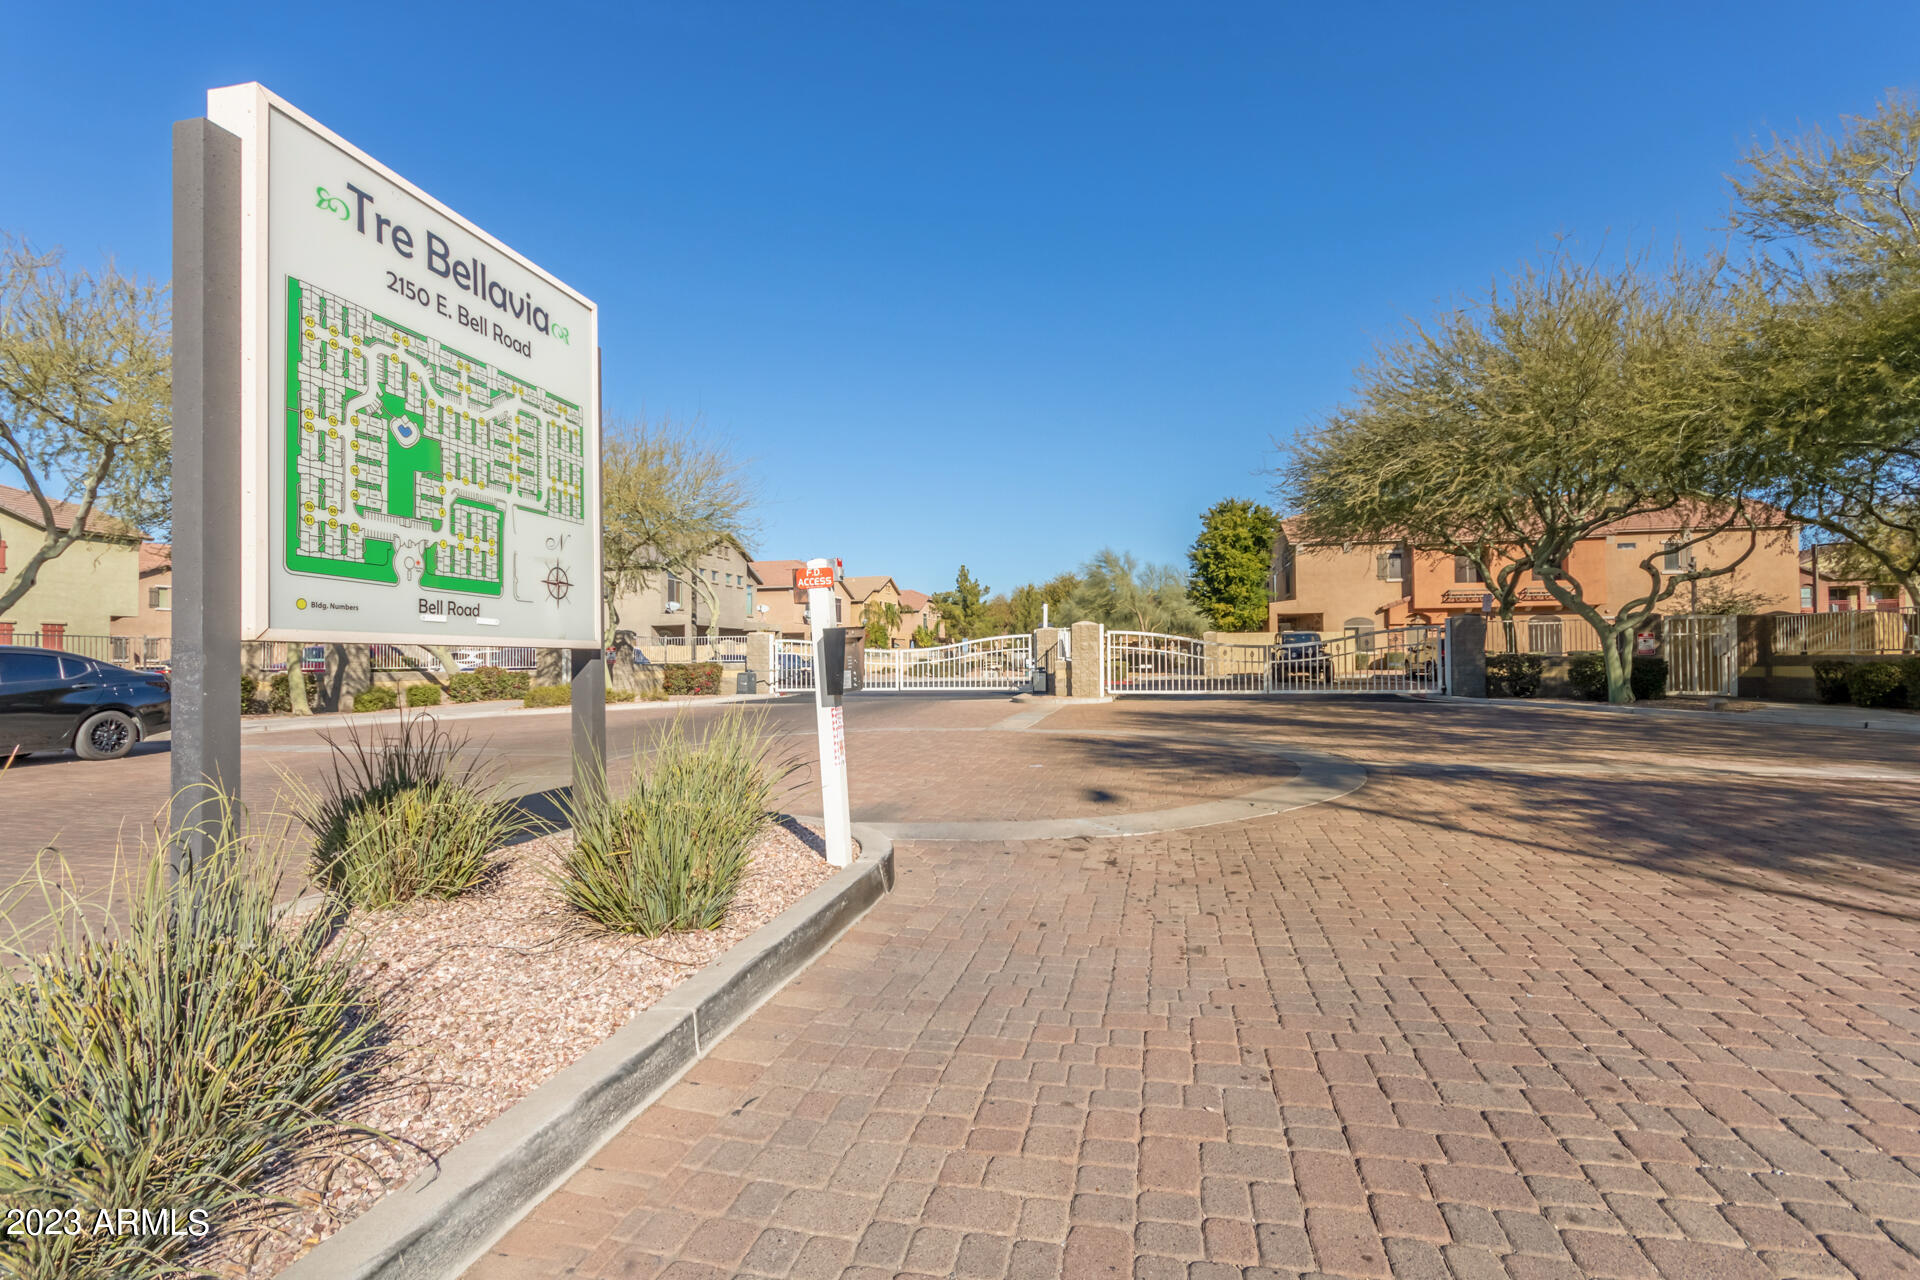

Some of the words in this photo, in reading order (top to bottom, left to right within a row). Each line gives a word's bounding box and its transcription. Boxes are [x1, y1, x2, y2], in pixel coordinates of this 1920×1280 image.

[347, 182, 414, 259] Tre
[427, 230, 549, 336] Bellavia
[386, 271, 430, 307] 2150
[437, 293, 452, 319] E.
[458, 304, 487, 337] Bell
[493, 323, 532, 358] Road
[806, 568, 823, 577] F.D.
[797, 576, 832, 586] ACCESS
[310, 601, 328, 610] Bldg.
[330, 602, 359, 611] Numbers
[418, 598, 443, 615] Bell
[448, 600, 480, 617] Road
